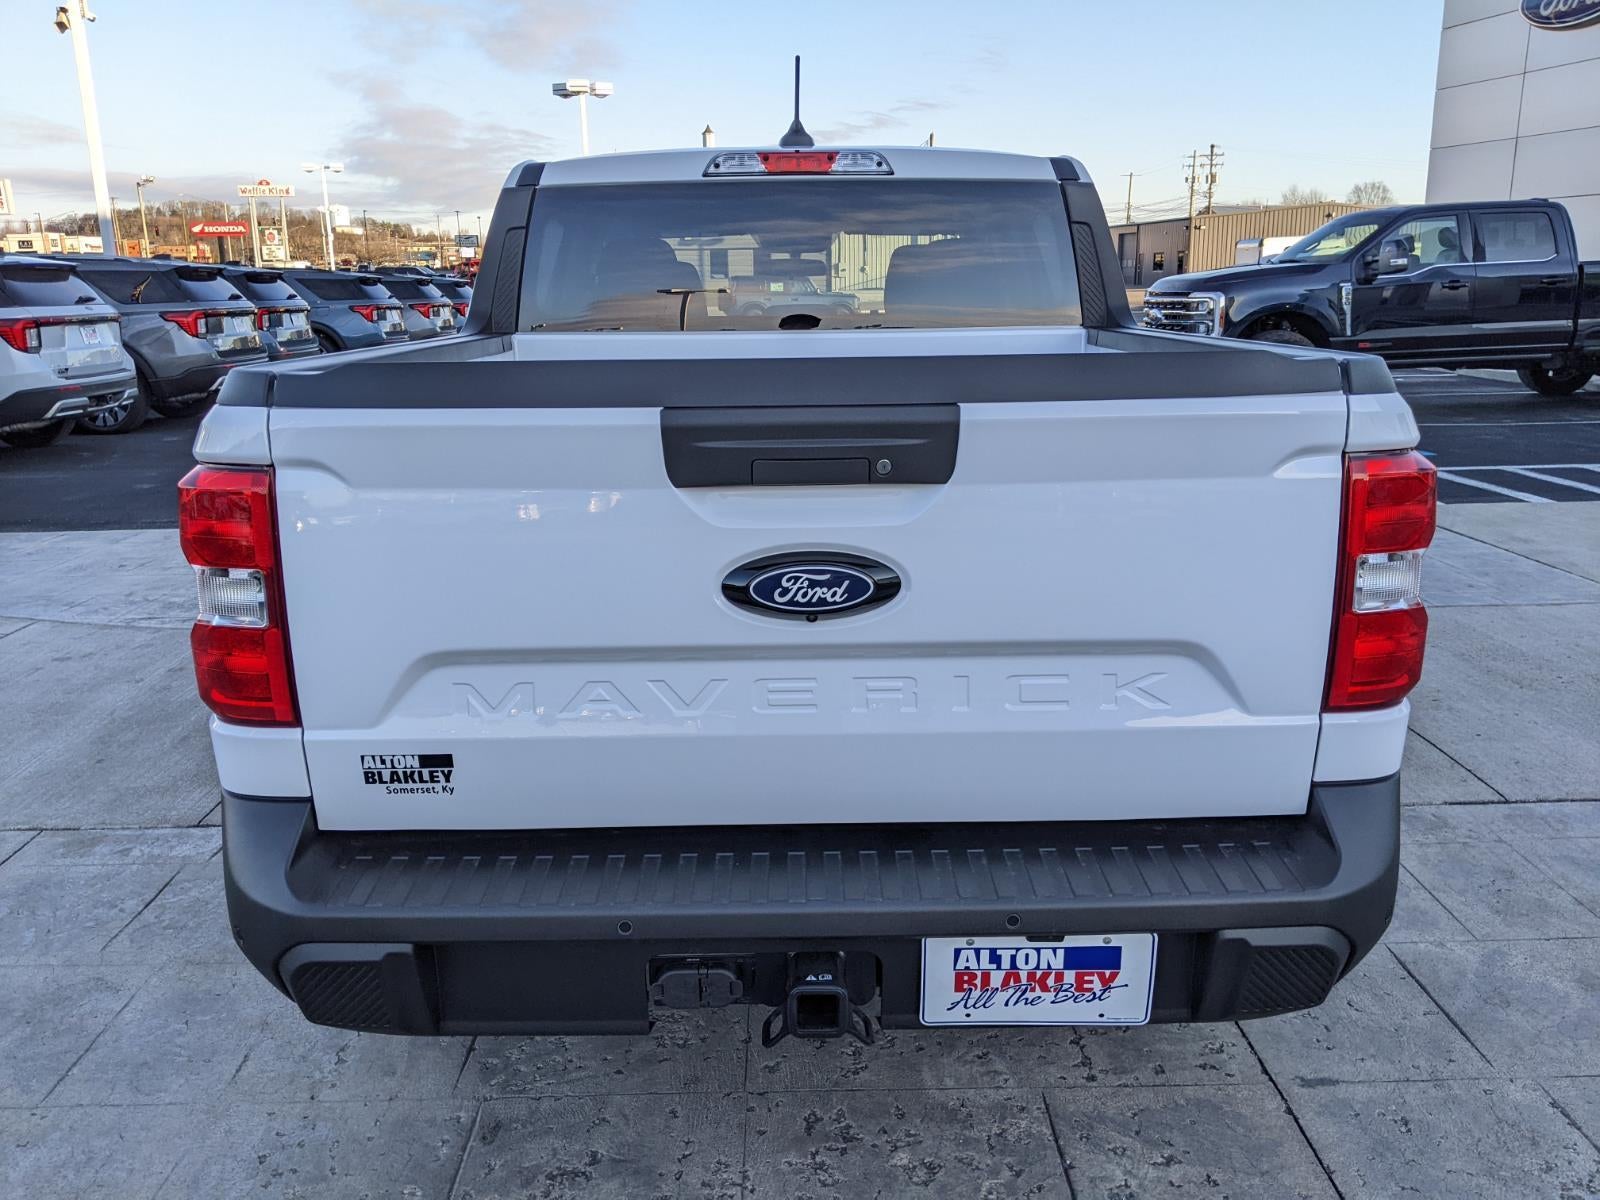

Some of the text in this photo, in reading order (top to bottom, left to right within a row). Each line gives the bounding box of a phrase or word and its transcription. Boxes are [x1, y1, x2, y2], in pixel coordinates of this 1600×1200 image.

[203, 225, 247, 233] HONDA
[773, 572, 851, 604] Ford
[450, 672, 1172, 718] MAVERICK
[362, 755, 420, 769] ALTON
[363, 769, 453, 785] BLAKLEY
[385, 784, 455, 796] Somerset, Ky
[954, 948, 1065, 970] ALTON
[954, 971, 1120, 993] BLAKLEY
[946, 982, 1129, 1011] All The Best
